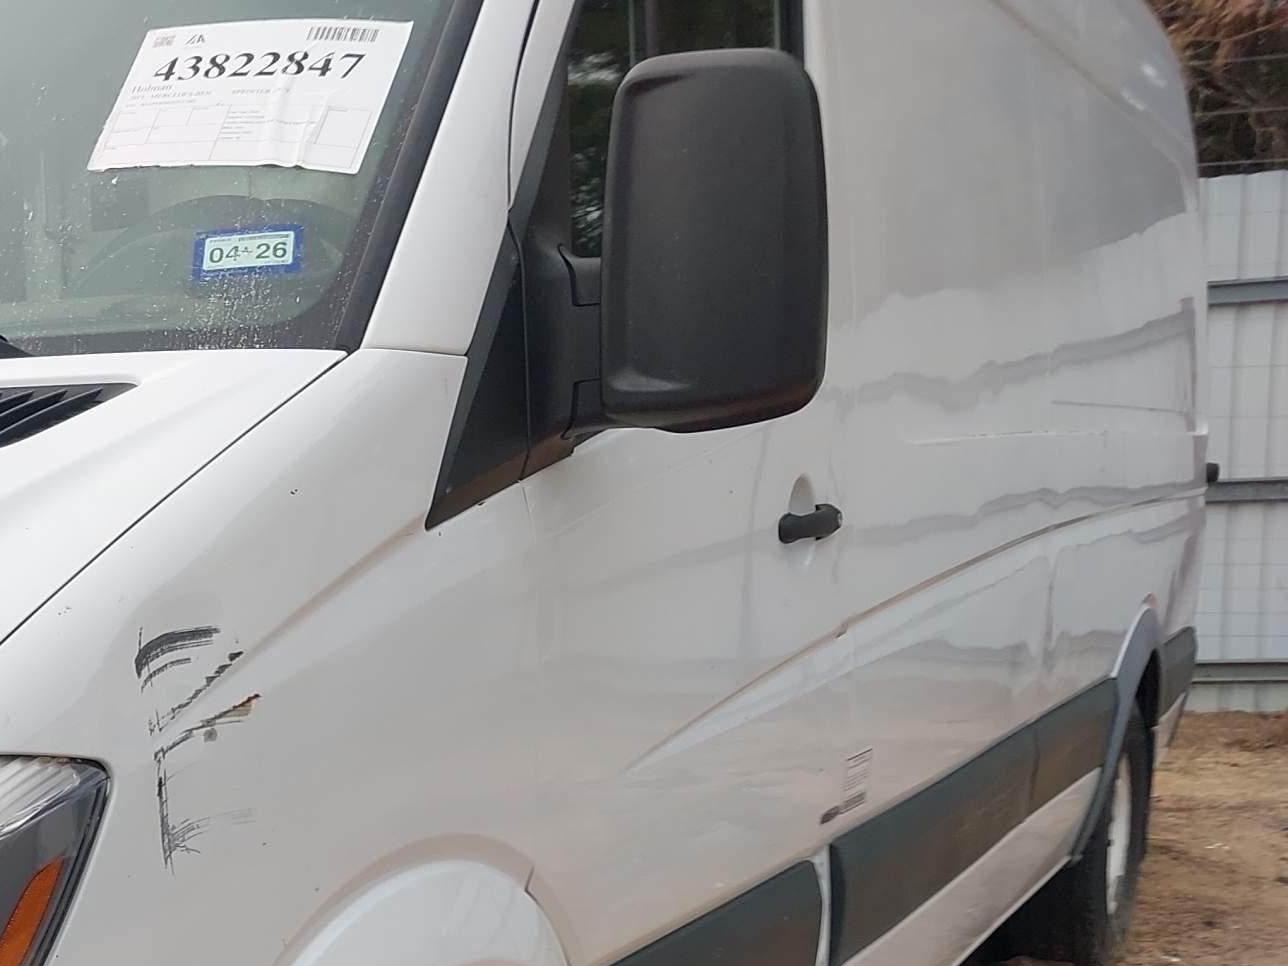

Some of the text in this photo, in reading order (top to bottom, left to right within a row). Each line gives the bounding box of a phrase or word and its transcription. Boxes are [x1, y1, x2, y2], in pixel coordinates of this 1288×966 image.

[153, 50, 365, 82] 43822847
[209, 241, 287, 263] 04 26
